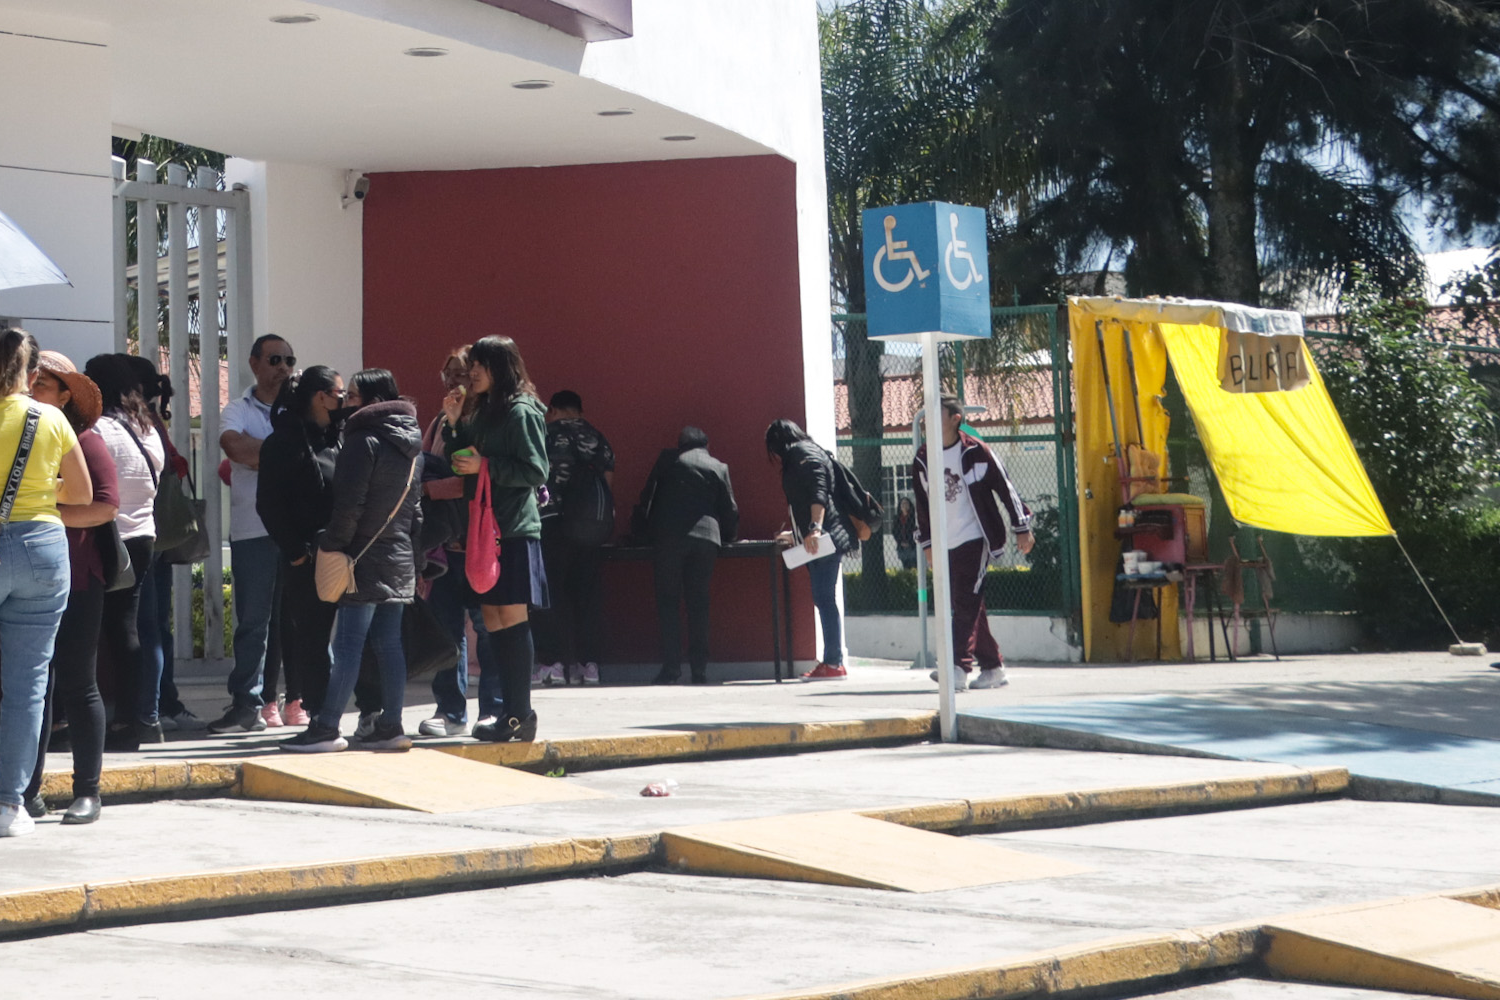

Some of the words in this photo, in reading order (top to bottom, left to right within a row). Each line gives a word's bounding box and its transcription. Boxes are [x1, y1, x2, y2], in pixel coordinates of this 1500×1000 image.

[0, 494, 13, 520] IMBA
[11, 457, 26, 482] LOLA
[21, 418, 38, 450] BIMBA
